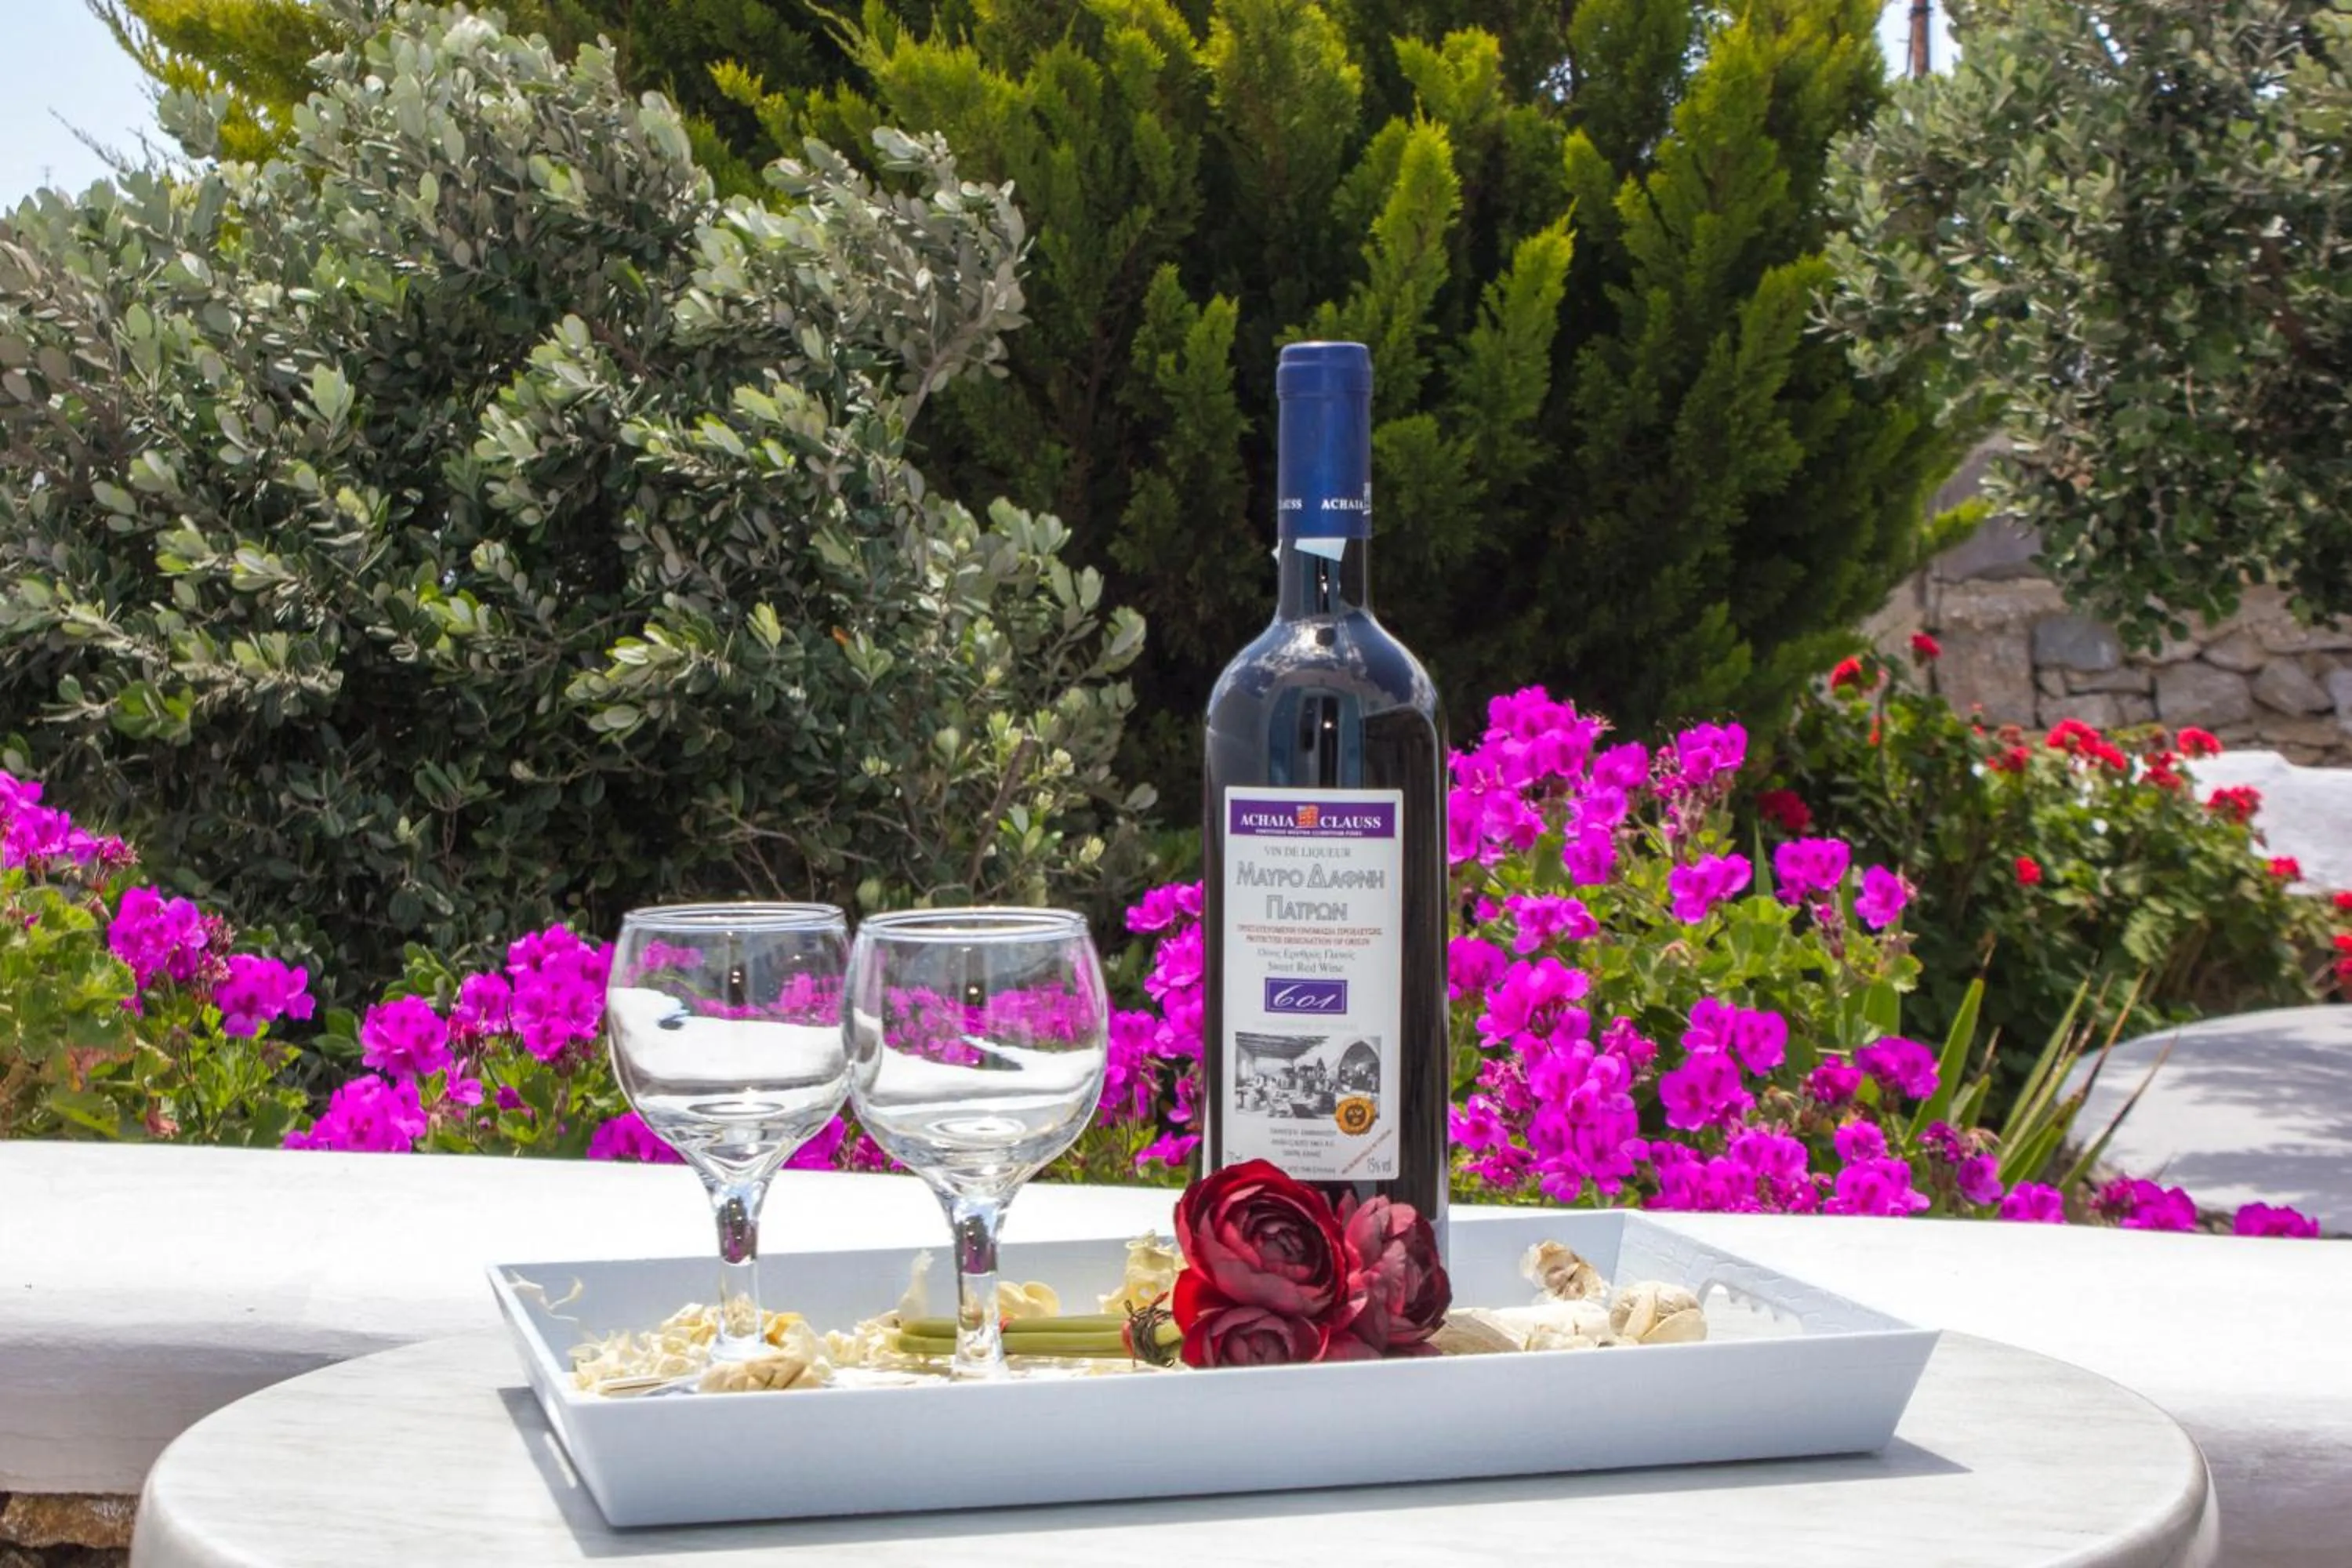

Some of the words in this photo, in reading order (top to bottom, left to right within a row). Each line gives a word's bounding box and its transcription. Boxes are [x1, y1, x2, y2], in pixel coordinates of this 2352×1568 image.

[1240, 813, 1294, 827] ACHAIA
[1319, 815, 1382, 829] CLAUSS
[1264, 846, 1282, 857] VIN
[1284, 847, 1299, 858] DE
[1301, 847, 1352, 858] LIQUEUR
[1297, 962, 1316, 973] Red
[1273, 984, 1337, 1009] 601
